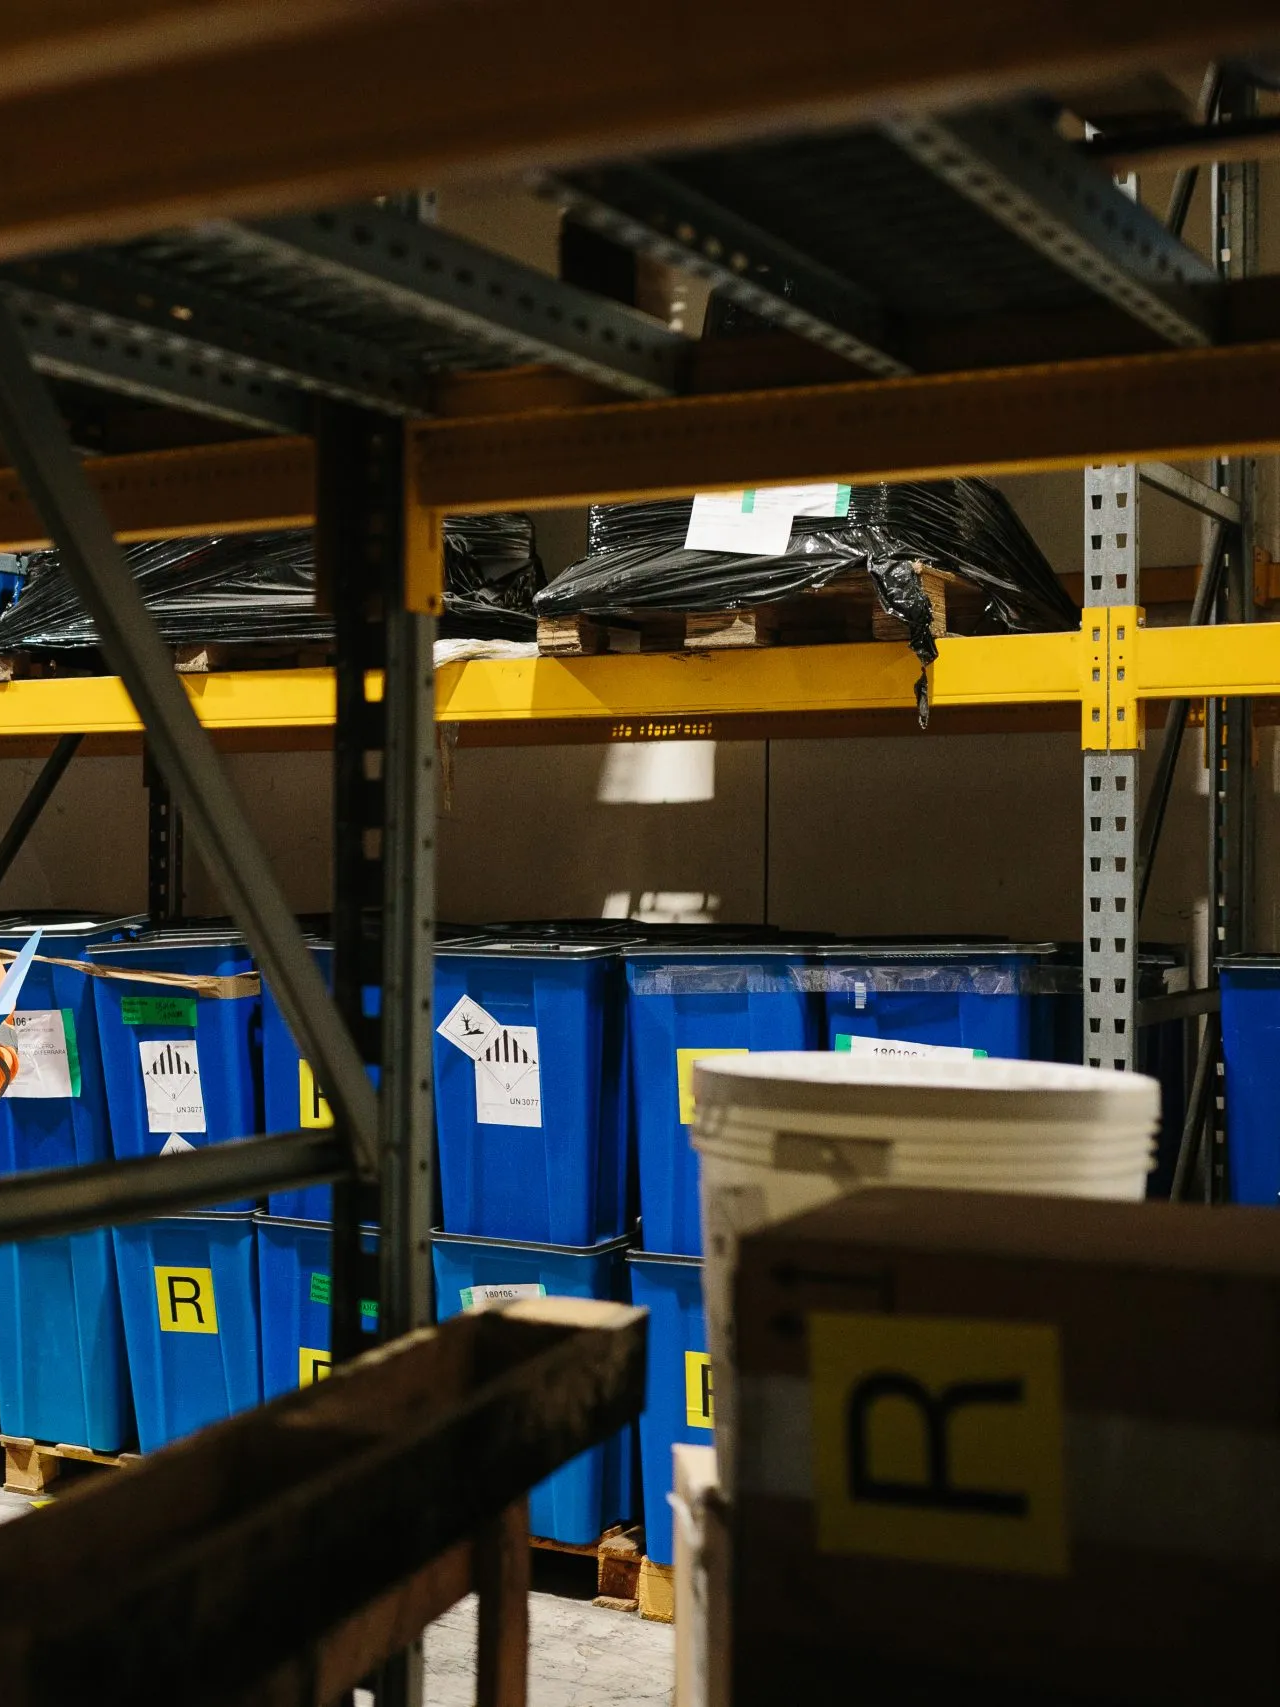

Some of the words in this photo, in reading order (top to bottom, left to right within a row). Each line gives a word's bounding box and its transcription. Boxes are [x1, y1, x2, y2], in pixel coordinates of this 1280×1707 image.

[12, 1017, 27, 1027] 106
[522, 1098, 539, 1107] 3077
[485, 1290, 514, 1299] 180106
[167, 1276, 204, 1324] R
[846, 1369, 1030, 1516] R
